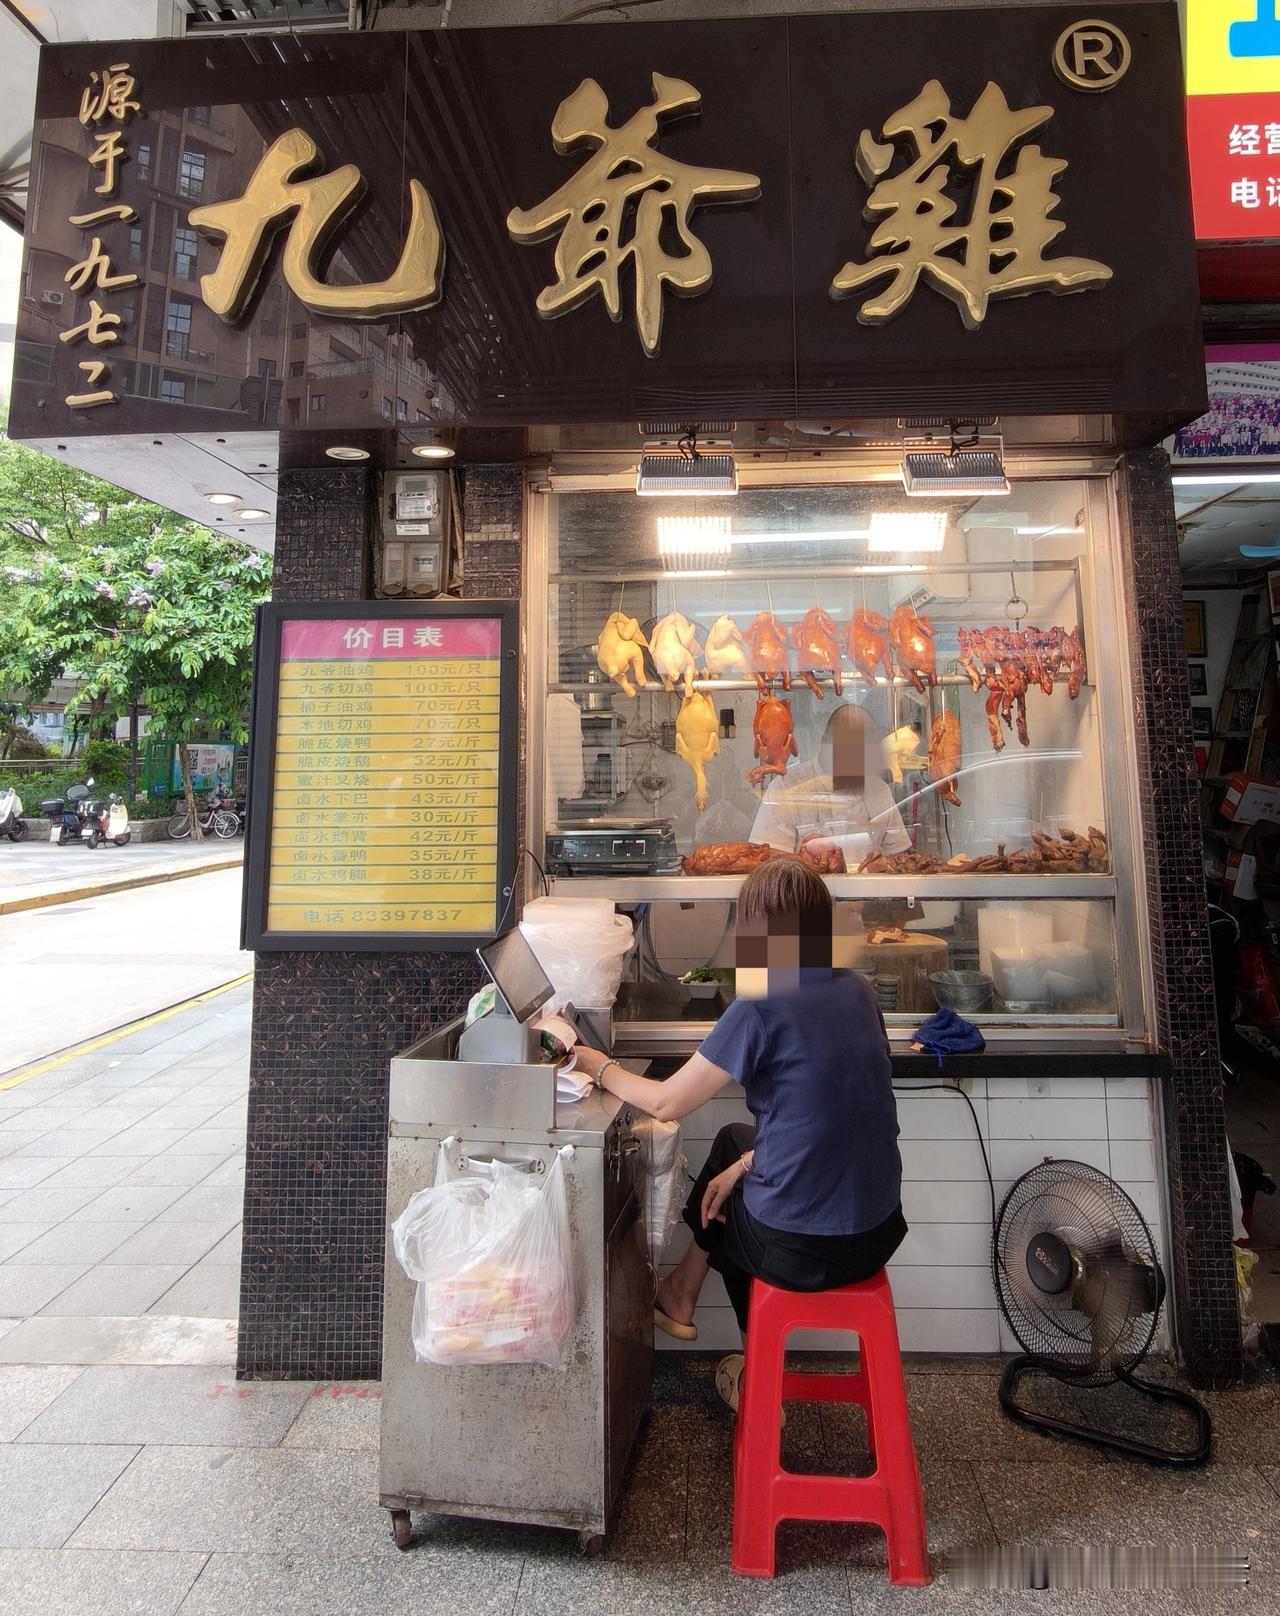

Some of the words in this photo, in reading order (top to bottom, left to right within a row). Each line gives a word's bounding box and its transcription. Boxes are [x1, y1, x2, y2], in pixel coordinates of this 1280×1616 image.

[59, 62, 142, 410] 源于一九七二
[342, 626, 443, 649] 价目表
[300, 664, 375, 677] 九爷油鸡
[405, 663, 482, 676] 100元/只
[300, 682, 374, 695] 九爷切鸡
[404, 681, 481, 694] 100元/只
[415, 699, 481, 712] 70元/只
[299, 719, 372, 731] 本地切鸡
[415, 718, 481, 730] 70元/只
[297, 737, 372, 750] 脆皮烧鸭
[413, 736, 480, 749] 27元/斤
[297, 755, 371, 768] 脆皮烧鹅
[296, 774, 370, 786] 蜜汁叉烧
[412, 772, 480, 785] 50元/斤
[296, 793, 369, 805] 卤水下巴
[411, 791, 480, 804] 43元/斤
[411, 810, 479, 823] 30元/斤
[295, 830, 368, 843] 卤水鹅肾
[410, 829, 479, 842] 42元/斤
[409, 848, 478, 861] 35元/斤
[292, 869, 367, 881] 卤水鸡脚
[409, 867, 478, 880] 38元/斤
[303, 909, 345, 923] 电话
[351, 909, 463, 922] 83397837
